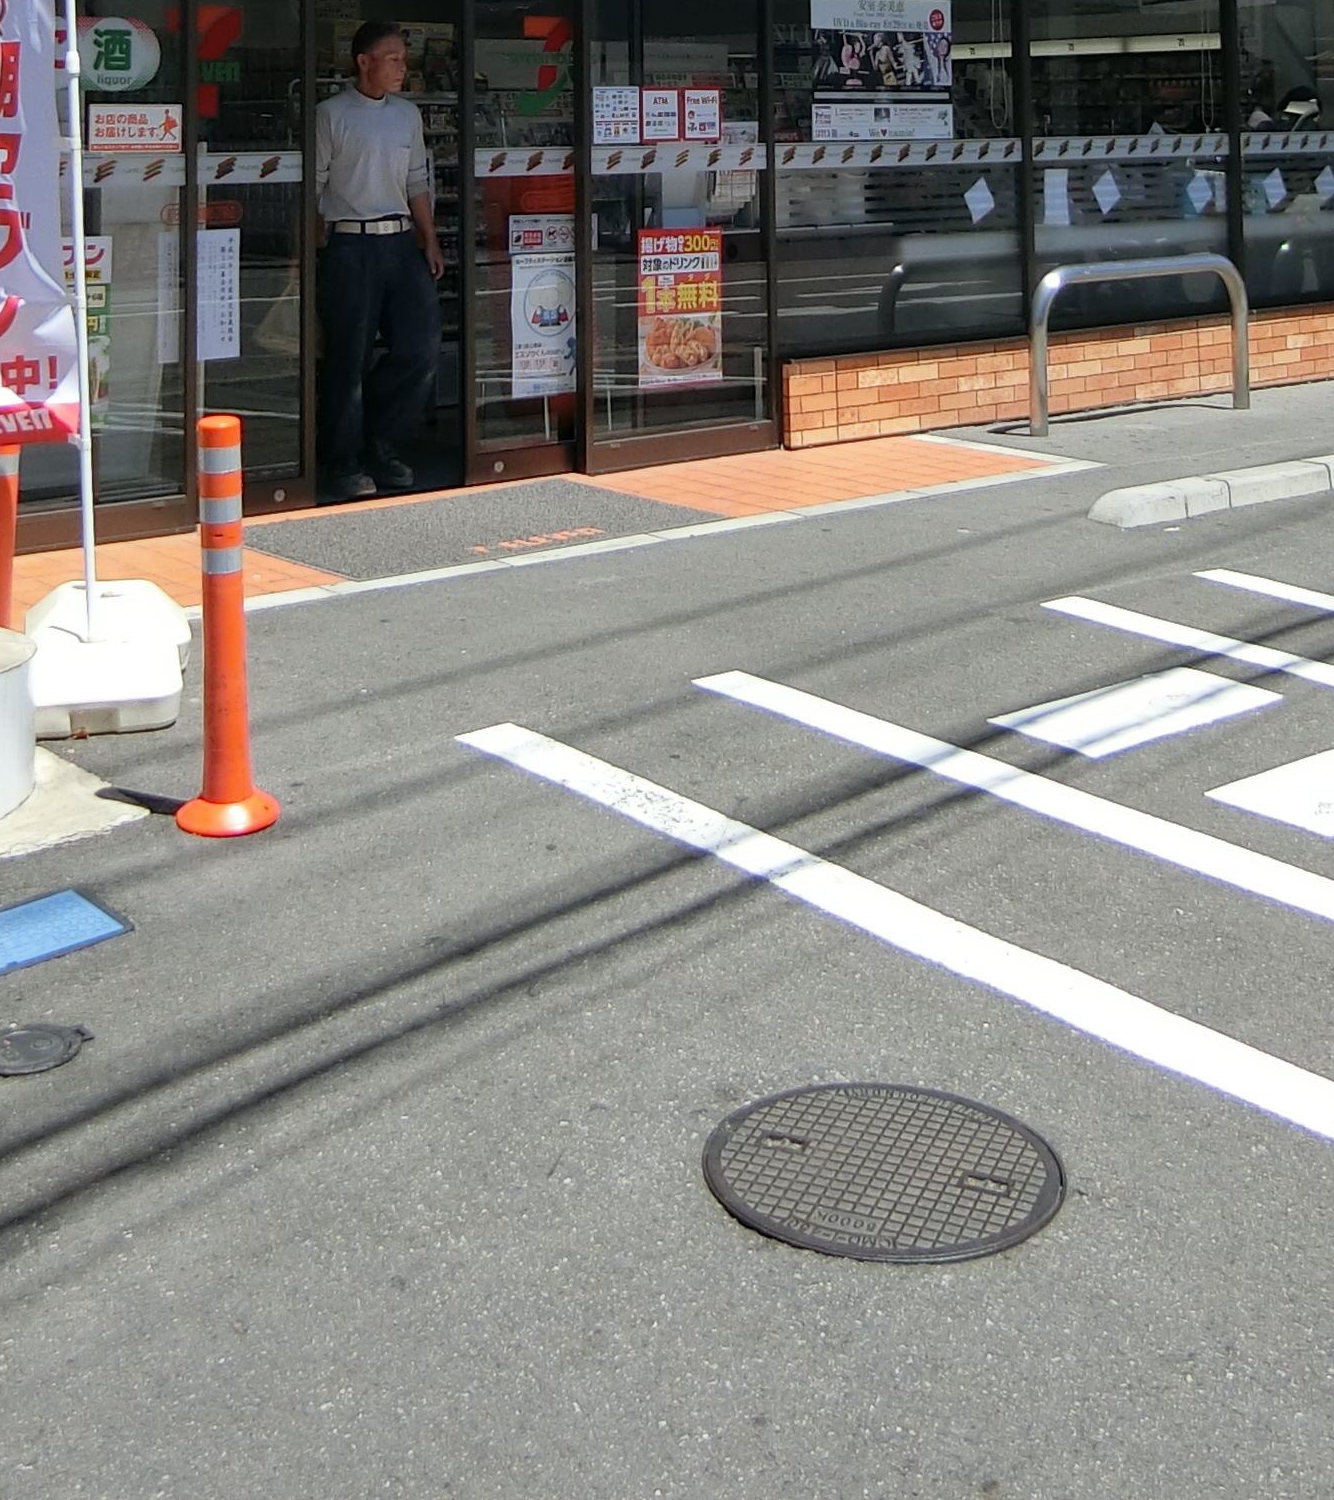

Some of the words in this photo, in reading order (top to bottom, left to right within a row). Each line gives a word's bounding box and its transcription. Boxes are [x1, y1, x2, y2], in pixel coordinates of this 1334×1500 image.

[93, 28, 132, 71] 酒
[97, 73, 133, 85] liquor
[652, 96, 669, 106] ATM
[94, 113, 149, 126] お店の商品
[642, 256, 701, 272] 対象のドリンク
